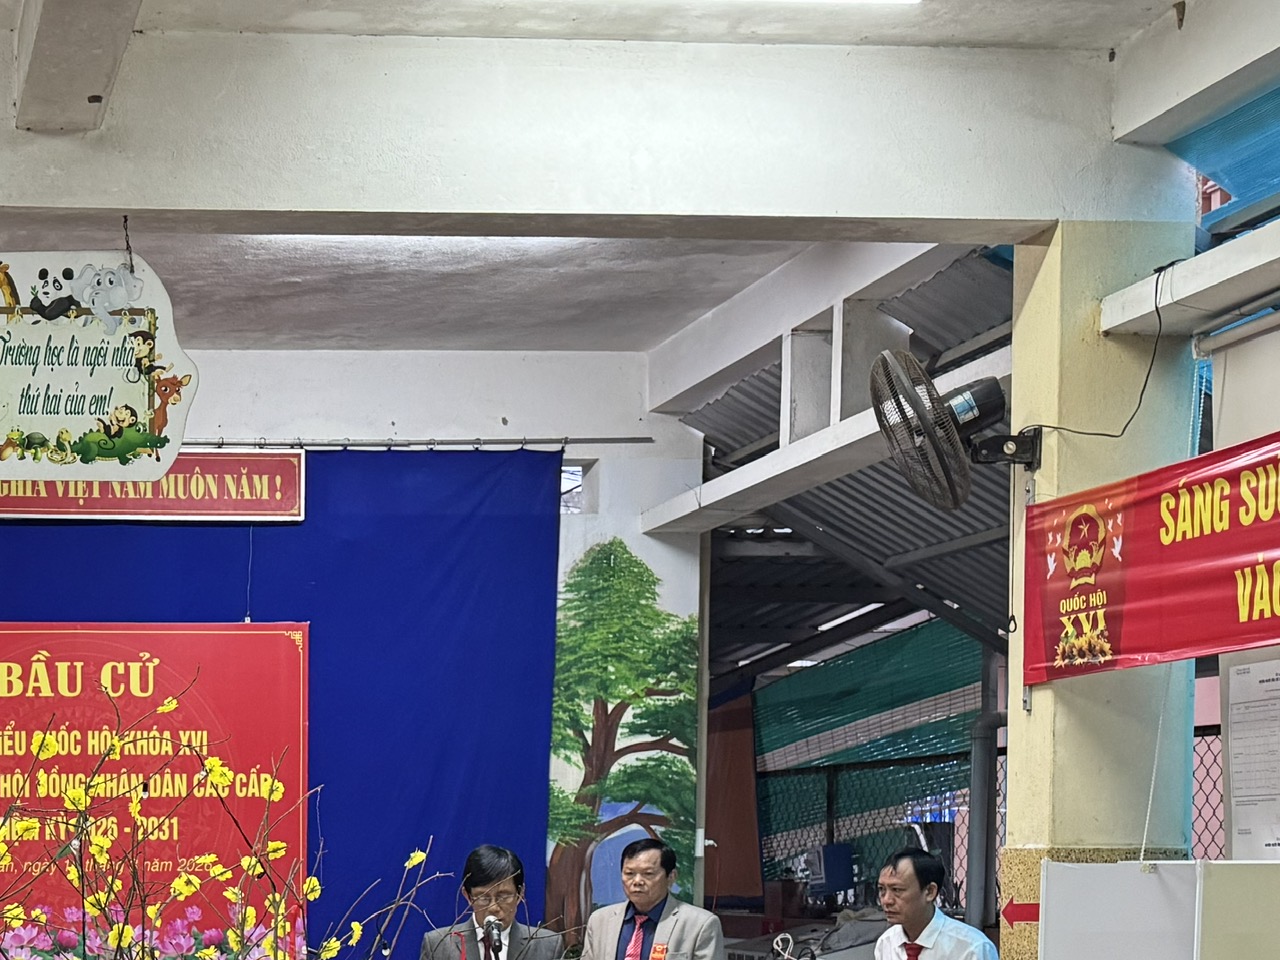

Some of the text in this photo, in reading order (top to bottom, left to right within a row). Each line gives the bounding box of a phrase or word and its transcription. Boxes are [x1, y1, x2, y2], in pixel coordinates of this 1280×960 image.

[43, 334, 65, 372] học
[66, 334, 79, 367] là
[82, 338, 110, 377] ngôi
[111, 335, 135, 367] nhà
[18, 381, 114, 415] thứ hai của em!
[108, 481, 153, 499] NAM
[158, 466, 218, 499] MUÔN
[223, 467, 270, 500] NĂM
[275, 474, 282, 501] !
[1159, 451, 1280, 546] SÁNG SU
[1060, 589, 1107, 614] QUỐC HỘI
[1059, 608, 1107, 637] XVI
[100, 651, 161, 698] CỬ
[32, 721, 82, 756] ỐC
[87, 724, 118, 761] HỘ
[123, 725, 173, 756] KHÓA
[178, 730, 208, 756] XVI
[0, 768, 30, 804] HỘI
[149, 768, 188, 798] DÂN
[45, 811, 67, 841] KỲ
[73, 815, 119, 841] 026
[137, 815, 179, 841] 2031
[23, 858, 59, 876] ngày
[144, 858, 172, 872] năm
